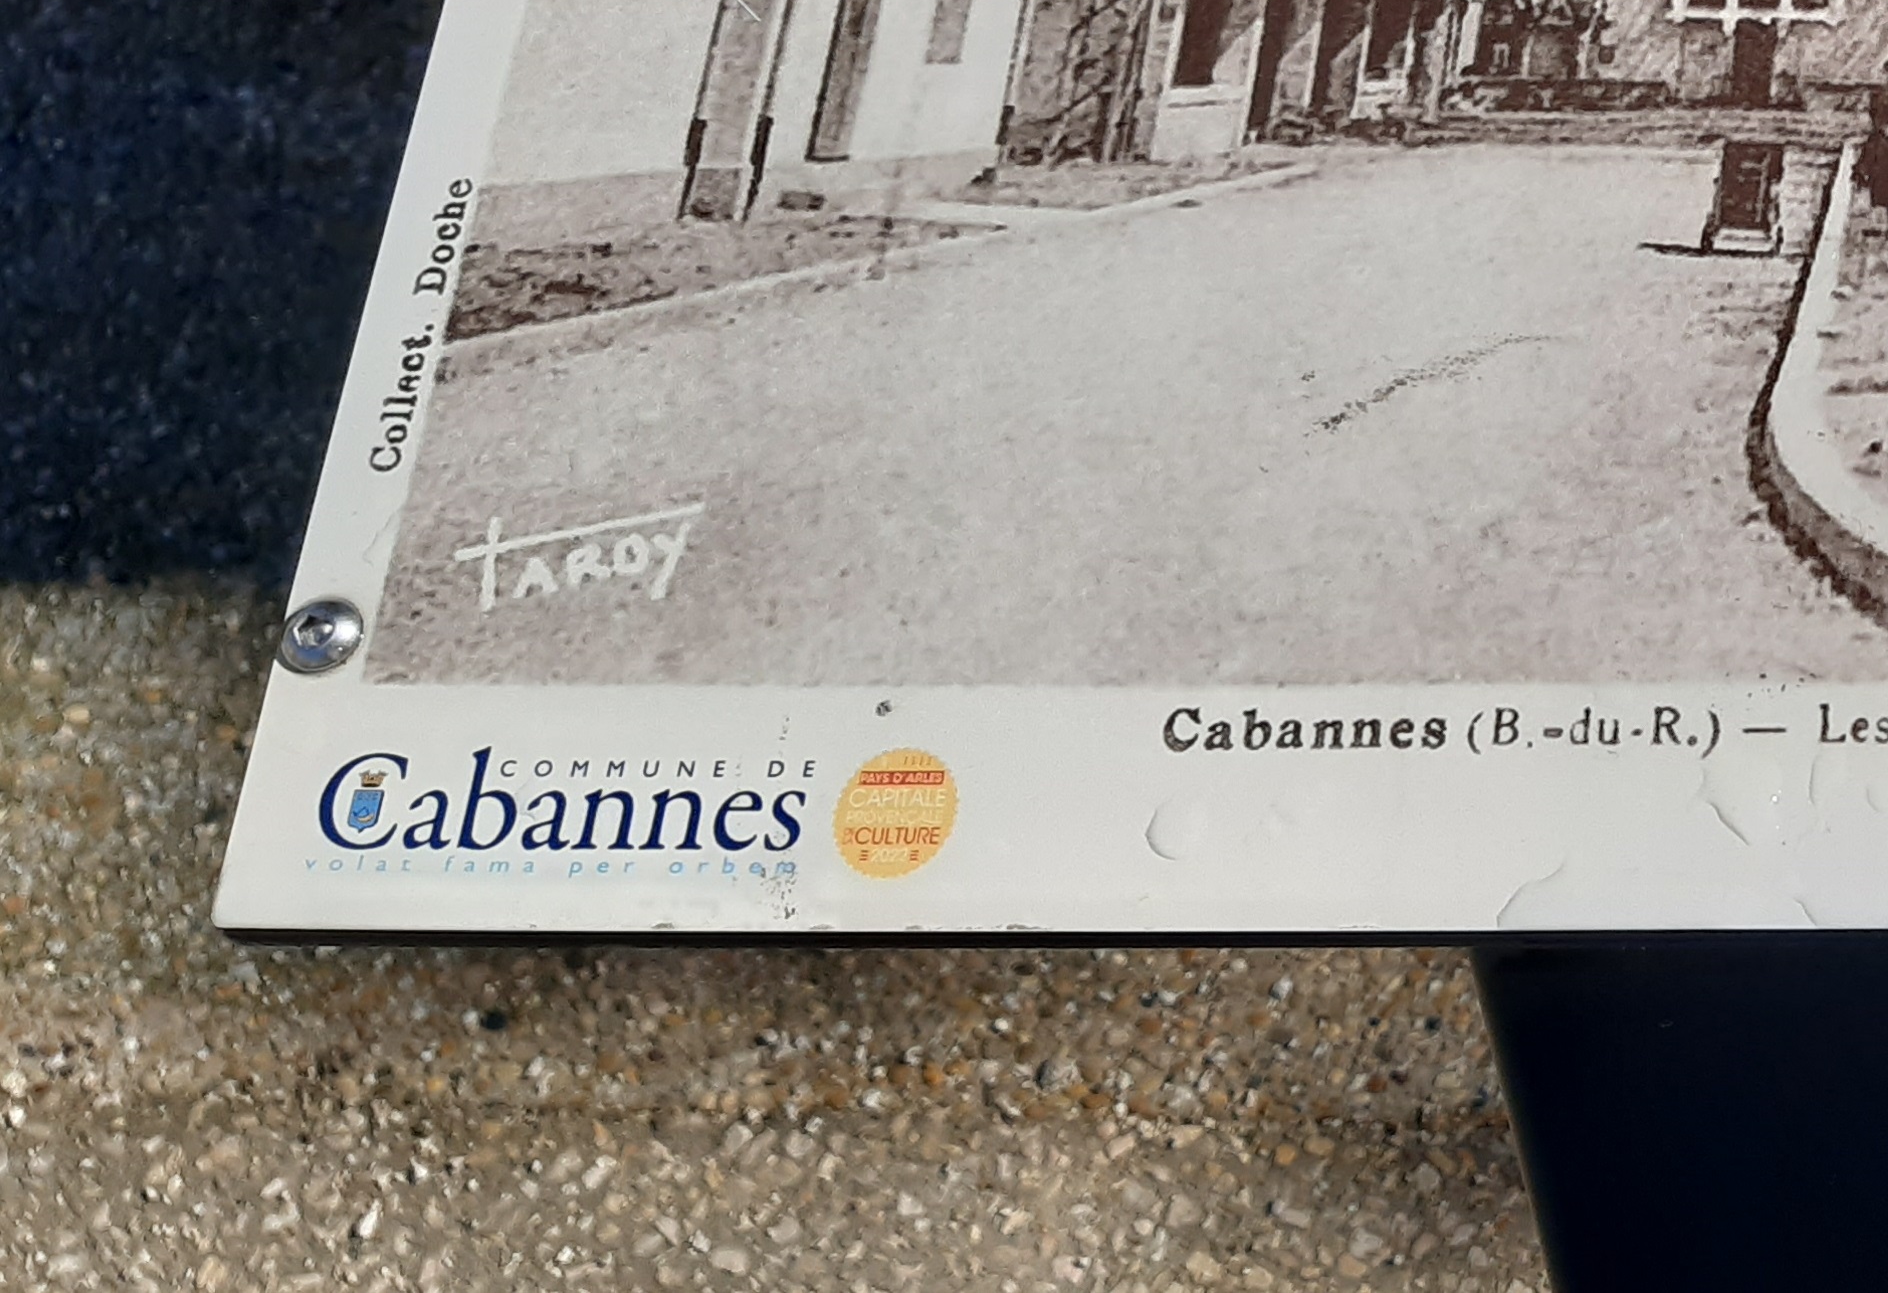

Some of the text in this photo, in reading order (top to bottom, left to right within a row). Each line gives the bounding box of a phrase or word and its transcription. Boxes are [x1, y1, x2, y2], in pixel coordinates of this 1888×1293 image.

[412, 178, 473, 296] Doche
[1162, 705, 1447, 752] Cabannes
[499, 759, 818, 779] COMMUNE DE
[860, 771, 889, 784] PAYS
[317, 746, 808, 851] Cabannes
[850, 788, 947, 807] CAPITALE
[854, 826, 941, 845] CULTURE
[304, 855, 798, 878] volat fama per orbem
